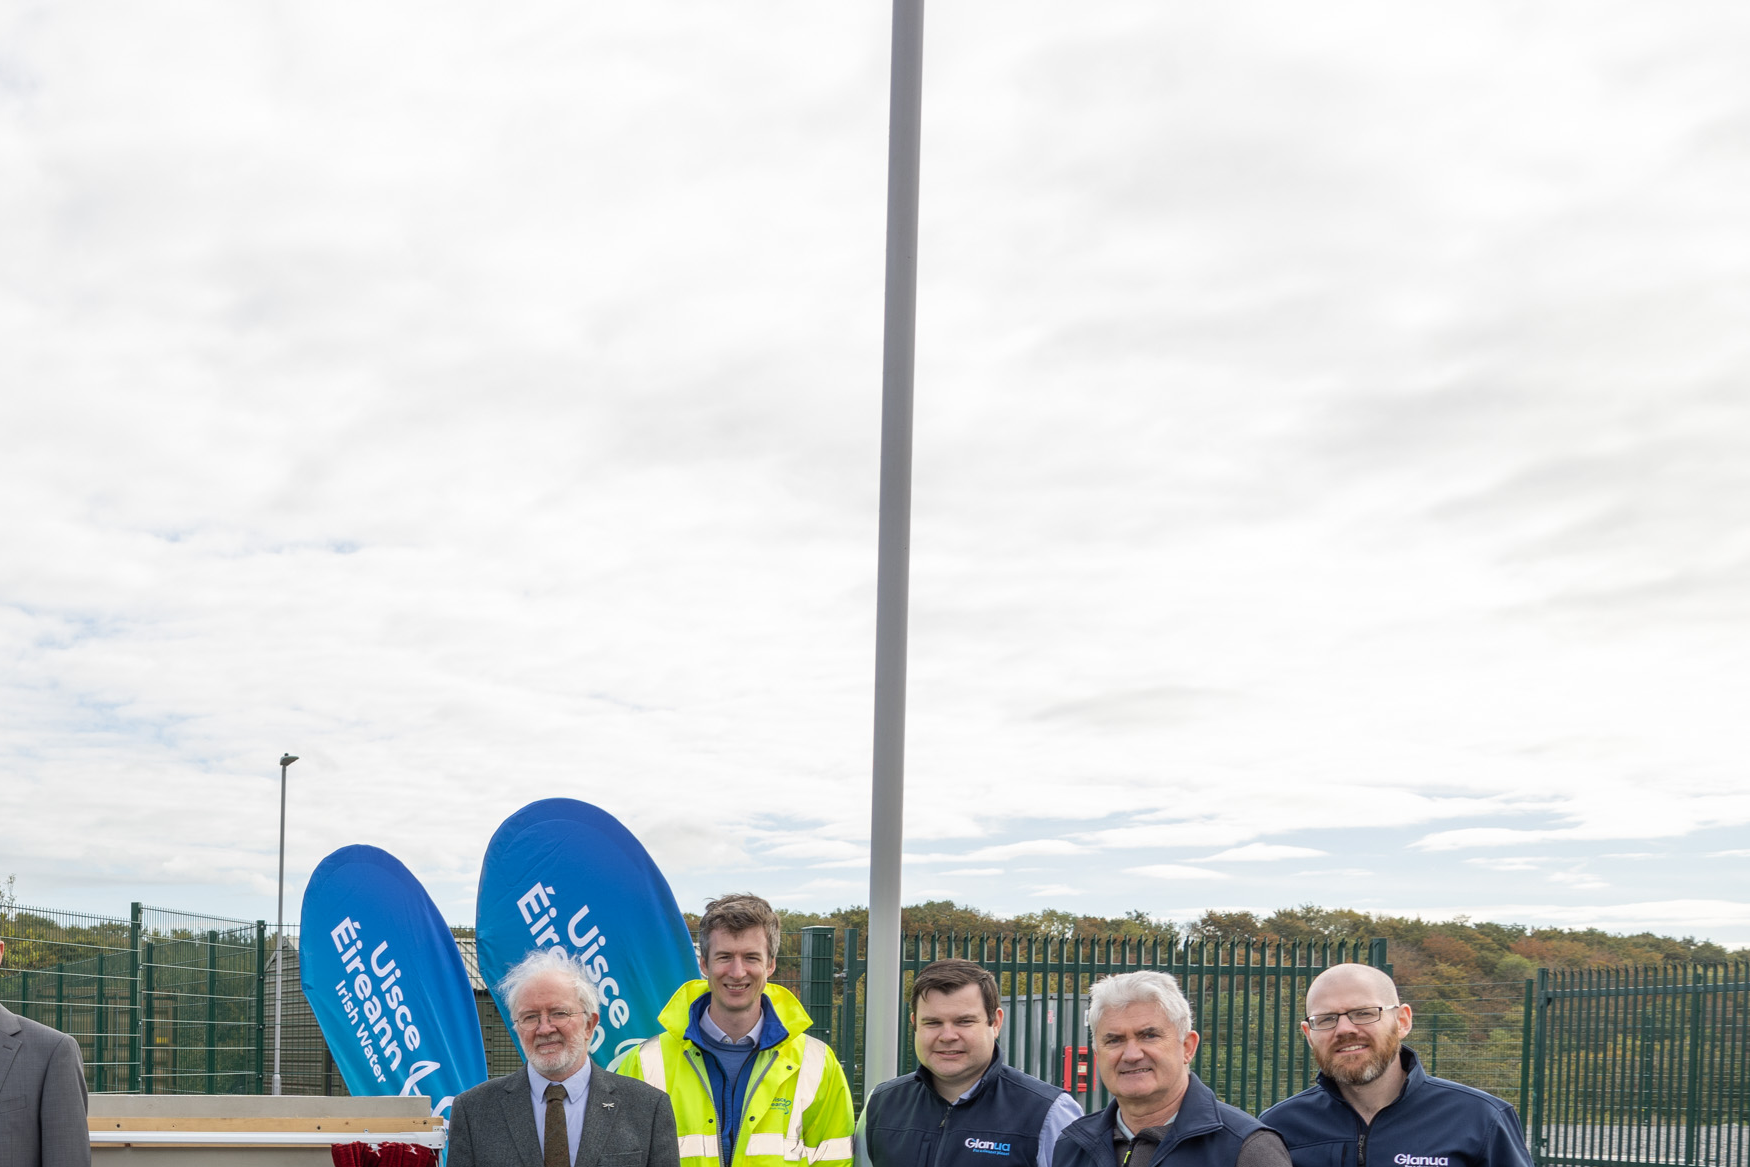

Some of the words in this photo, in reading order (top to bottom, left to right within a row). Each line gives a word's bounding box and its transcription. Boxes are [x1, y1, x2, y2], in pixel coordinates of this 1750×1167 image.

[330, 916, 403, 1072] Éireann
[371, 941, 421, 1052] Uisce
[567, 904, 630, 1030] Uisce
[335, 980, 359, 1026] Irish
[356, 1023, 387, 1084] Water
[964, 1138, 1010, 1152] Glanua
[1394, 1153, 1448, 1166] Glanua
